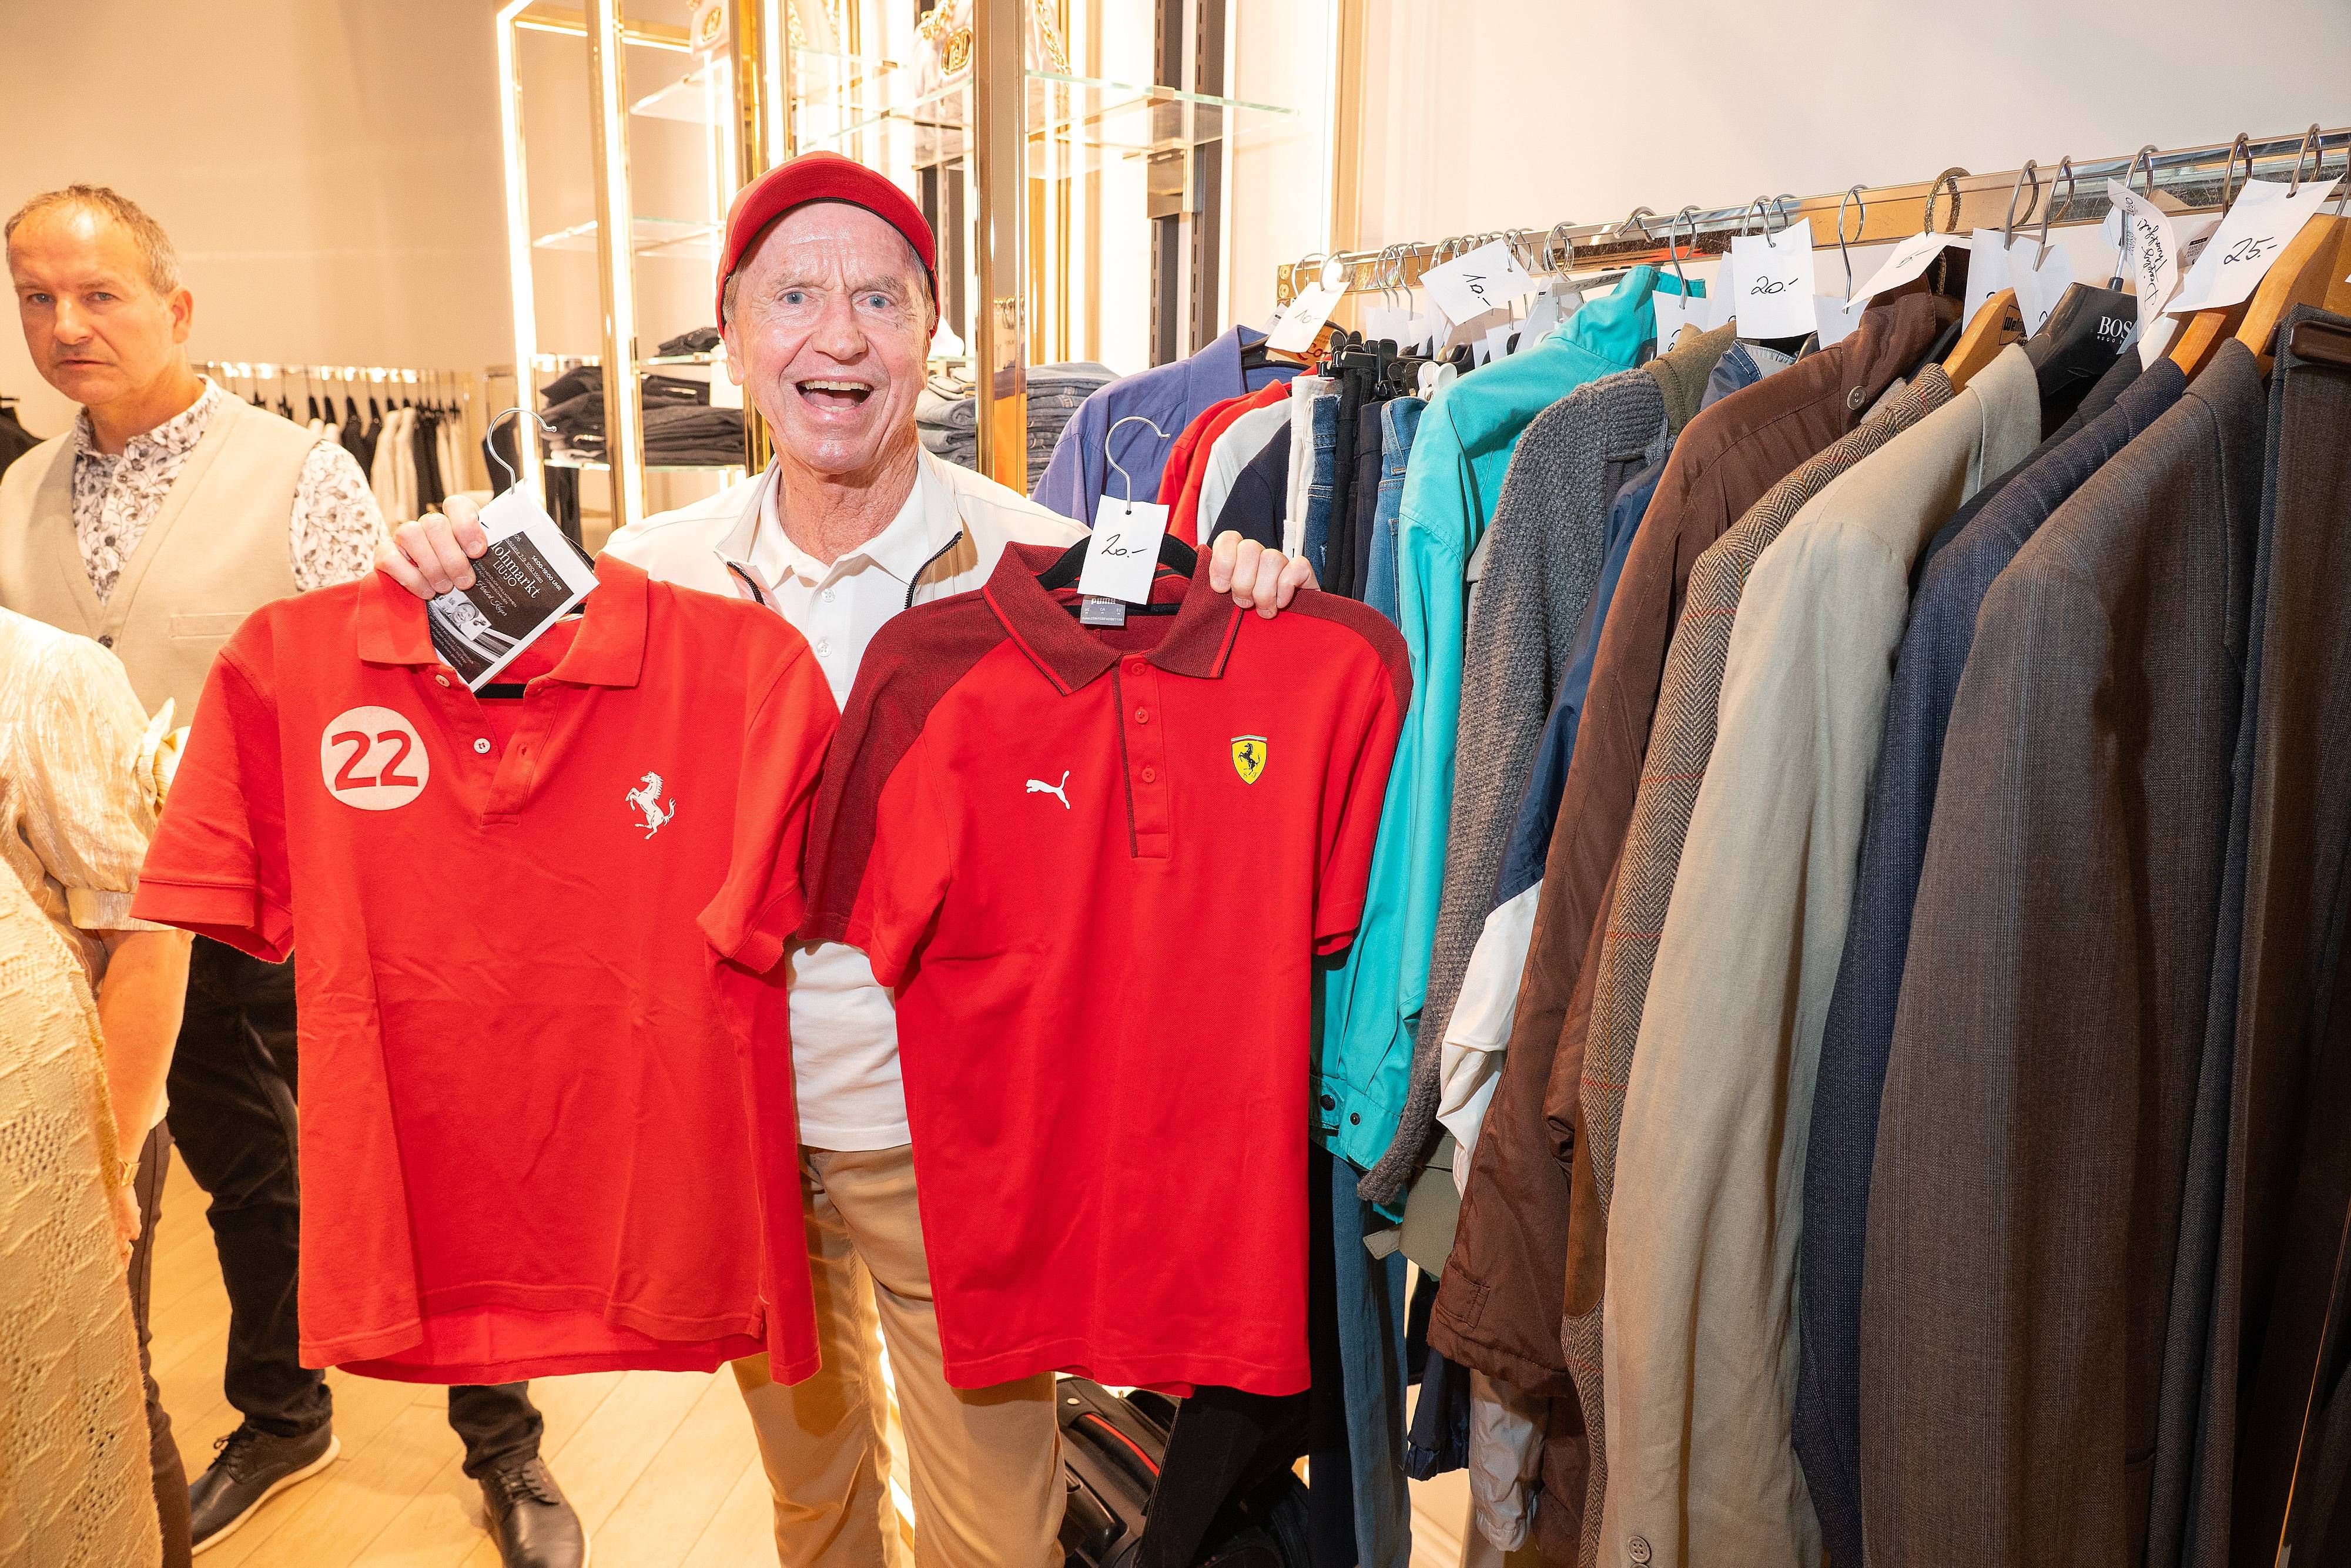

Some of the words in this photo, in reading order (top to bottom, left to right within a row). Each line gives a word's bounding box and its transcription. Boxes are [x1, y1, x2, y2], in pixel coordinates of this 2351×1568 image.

[2097, 316, 2132, 339] BOS
[491, 540, 541, 598] lohmarkt
[505, 538, 520, 555] ndstätte
[533, 571, 544, 584] Wien
[531, 555, 554, 581] 14:00-19:00
[551, 579, 562, 591] UHR
[331, 730, 418, 791] 22
